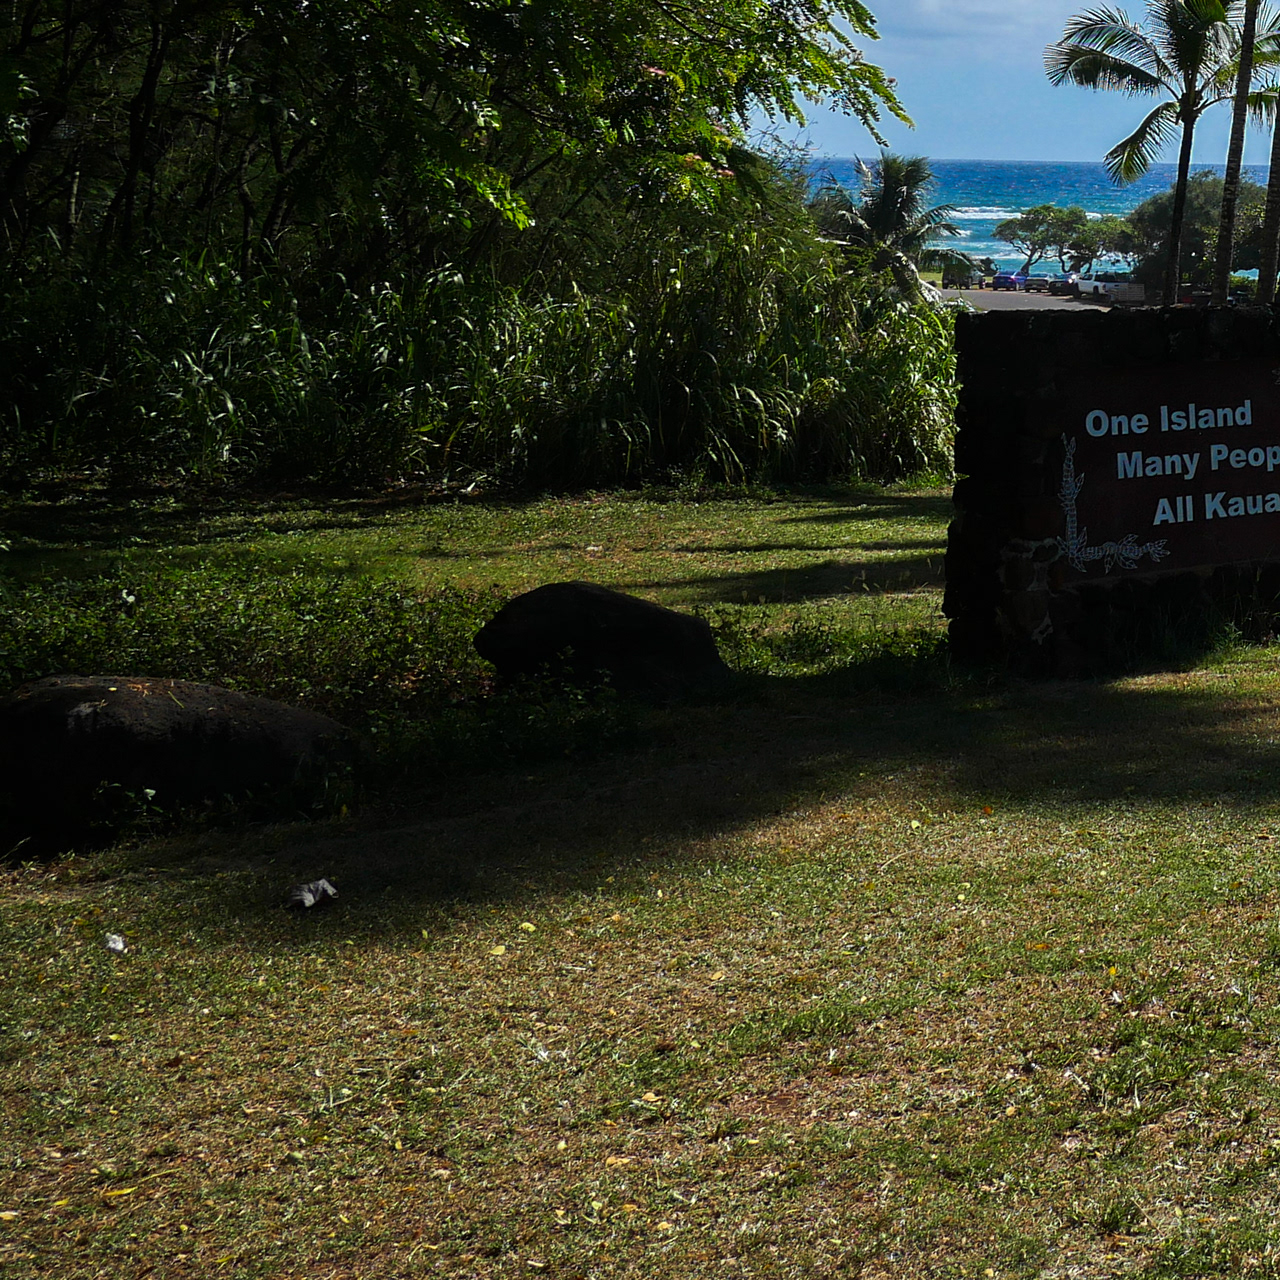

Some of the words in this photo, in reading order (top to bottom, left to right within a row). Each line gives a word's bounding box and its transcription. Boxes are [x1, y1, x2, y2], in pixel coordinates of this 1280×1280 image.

[1085, 409, 1149, 437] One
[1160, 399, 1253, 432] Island
[1116, 450, 1200, 481] Many
[1152, 495, 1194, 526] All
